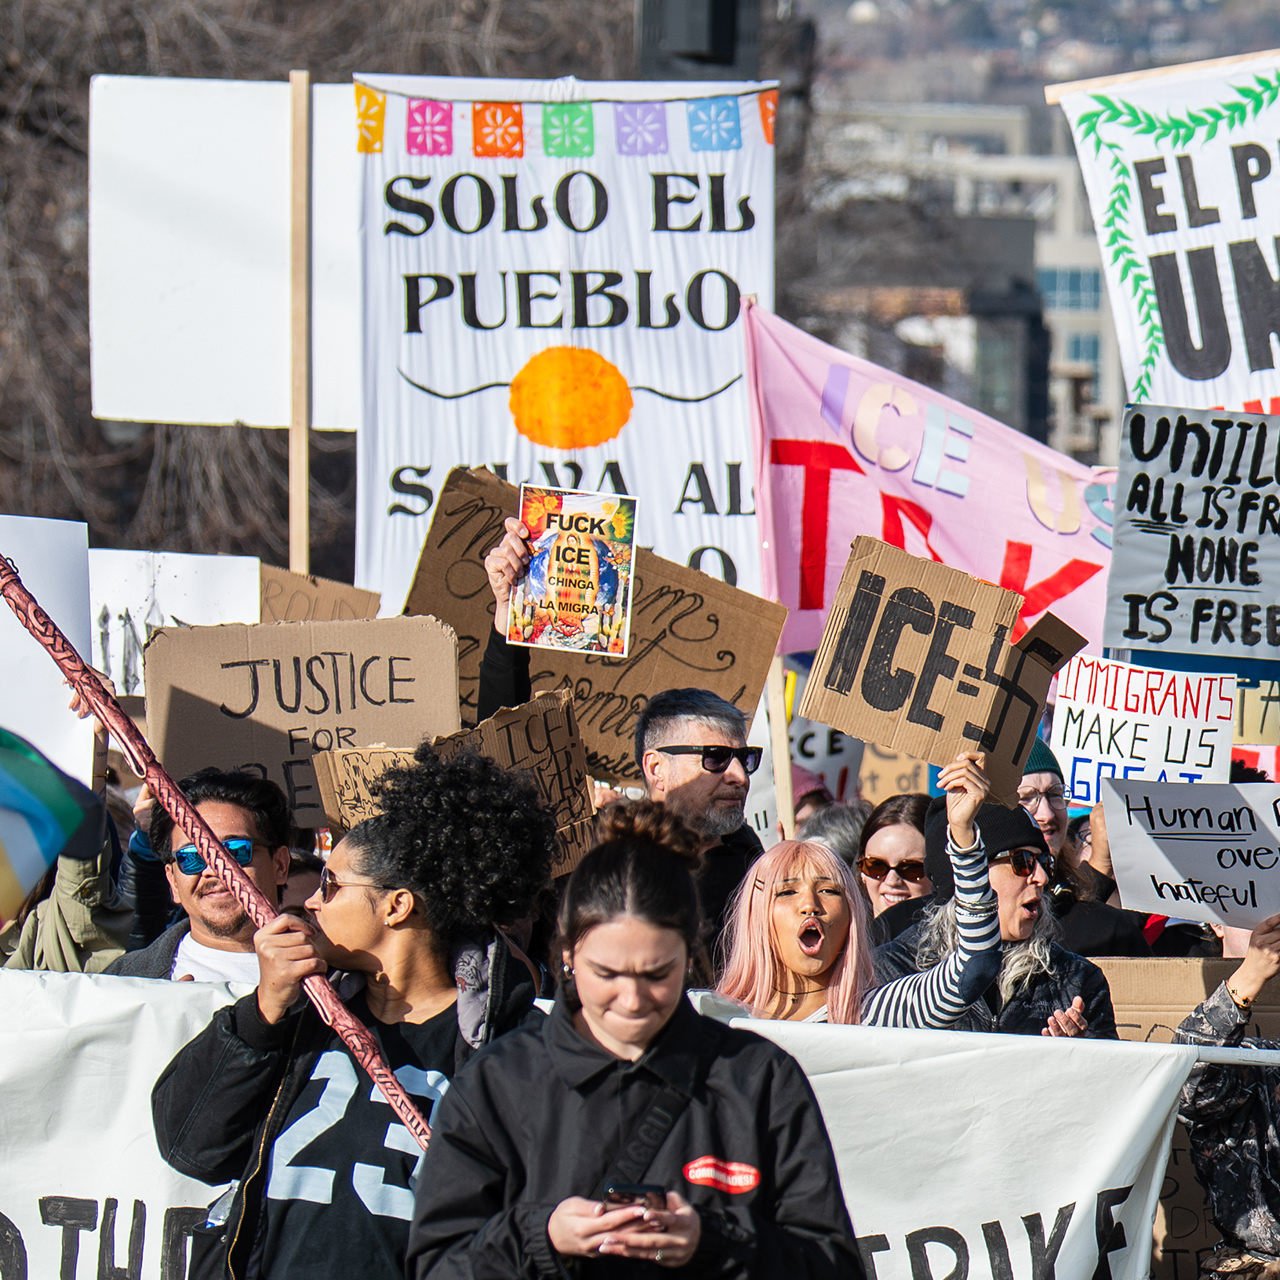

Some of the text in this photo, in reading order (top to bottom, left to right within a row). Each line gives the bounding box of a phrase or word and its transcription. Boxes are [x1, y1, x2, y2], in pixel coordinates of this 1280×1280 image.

[383, 171, 756, 237] SOLO EL
[1133, 155, 1221, 235] EL
[402, 269, 743, 334] PUEBLO
[821, 364, 975, 499] ICE
[546, 513, 606, 537] FUCK
[1127, 472, 1189, 524] ALL
[1195, 484, 1236, 529] IS
[555, 545, 590, 567] ICE
[1166, 535, 1262, 586] NONE
[539, 599, 601, 617] LA MIGRA
[547, 575, 596, 592] CHINGA
[1121, 592, 1179, 643] IS
[220, 652, 416, 719] JUSTICE
[1059, 655, 1237, 723] IMMIGRANTS
[287, 726, 357, 755] FOR
[495, 703, 578, 771] ICE!
[1062, 706, 1219, 769] MAKE US
[1124, 794, 1257, 835] Human
[1150, 872, 1258, 914] hateful
